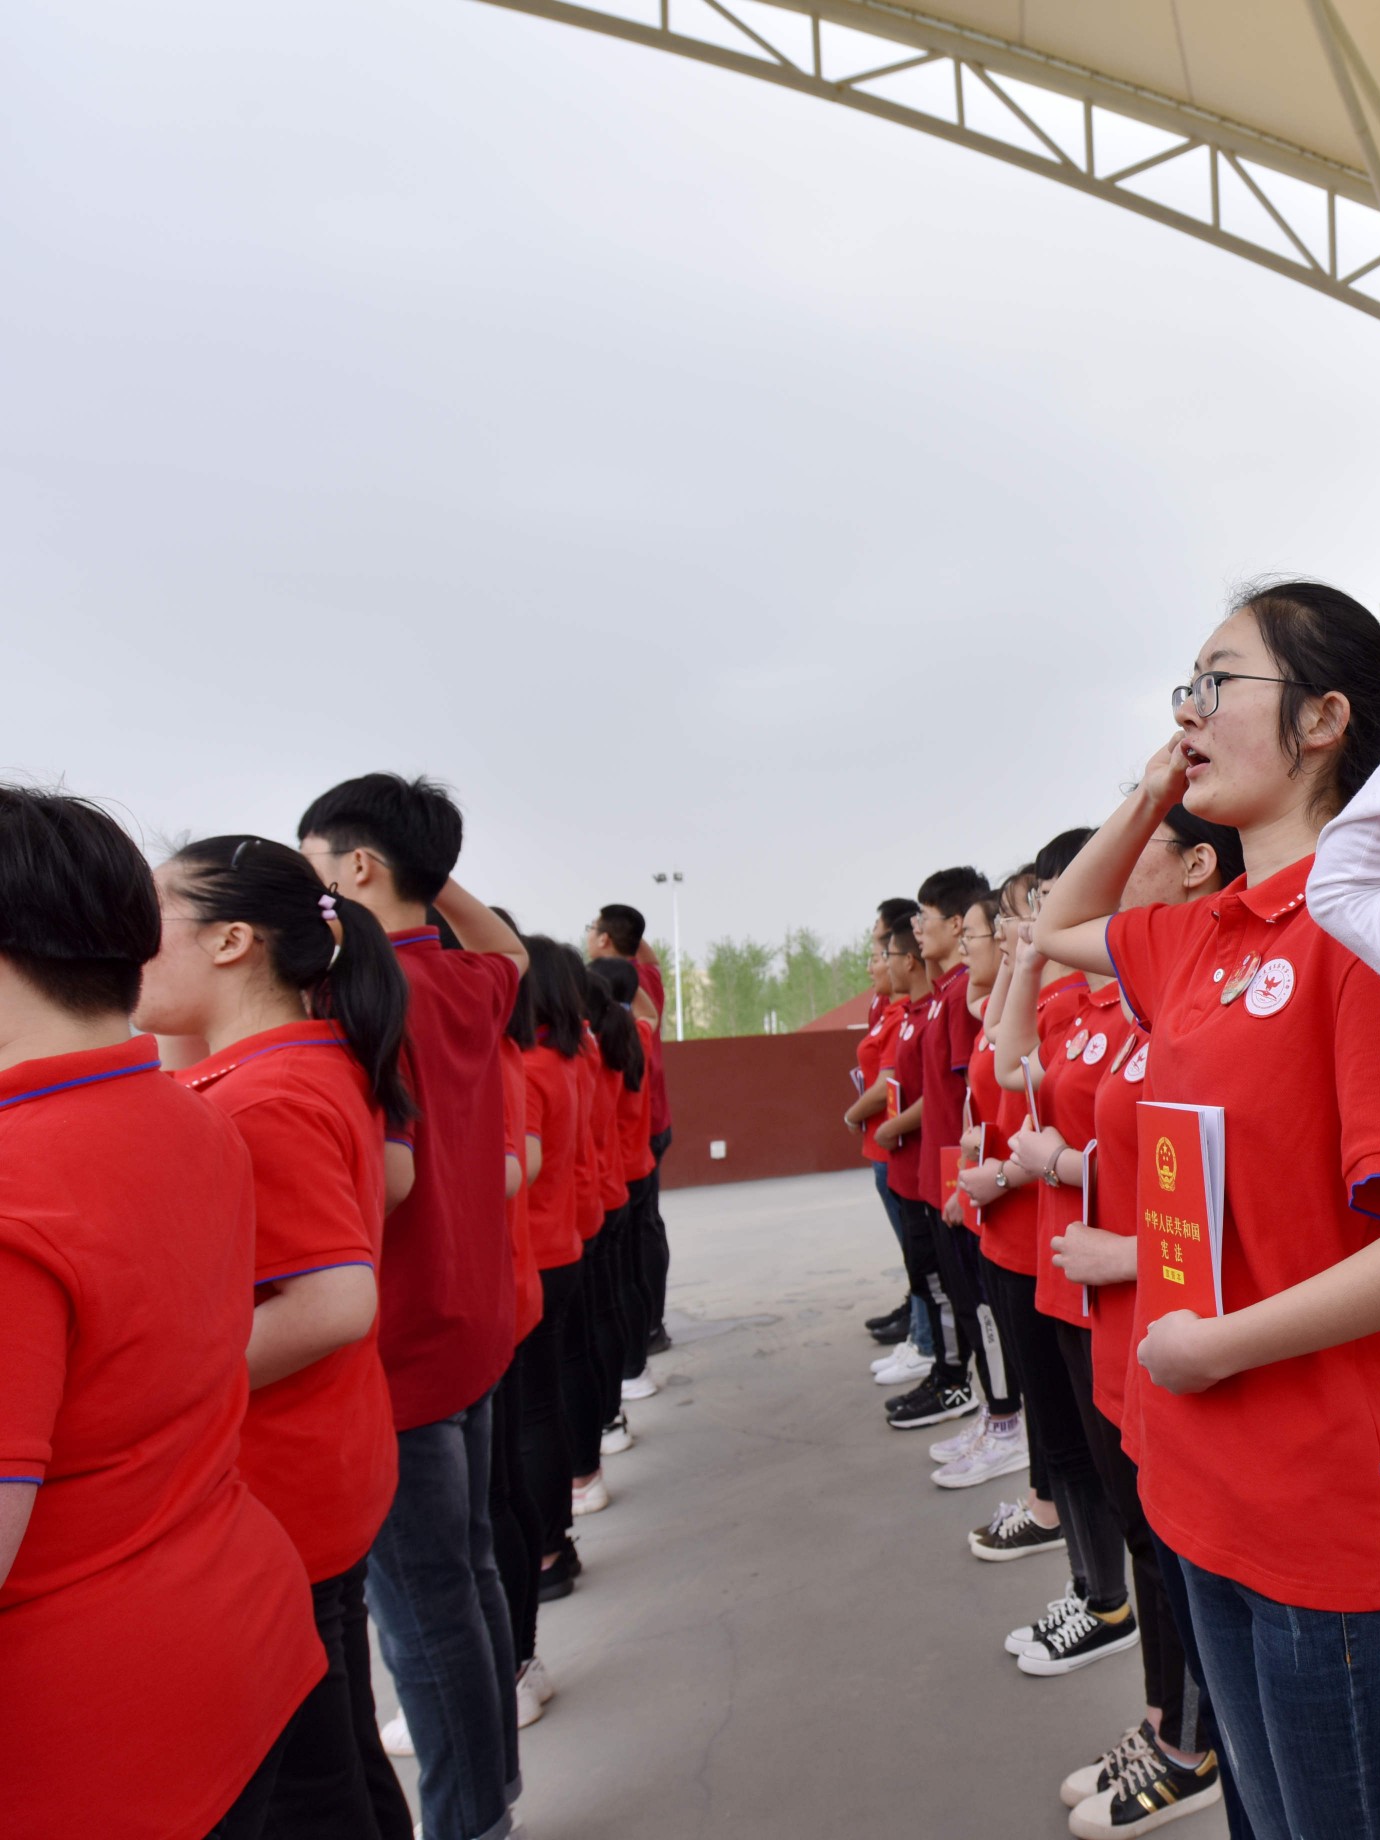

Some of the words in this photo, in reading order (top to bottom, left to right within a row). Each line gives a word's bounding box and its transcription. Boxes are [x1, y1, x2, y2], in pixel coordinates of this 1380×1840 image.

[1144, 1208, 1201, 1242] 中华人民共和国
[1160, 1239, 1184, 1263] 宪法
